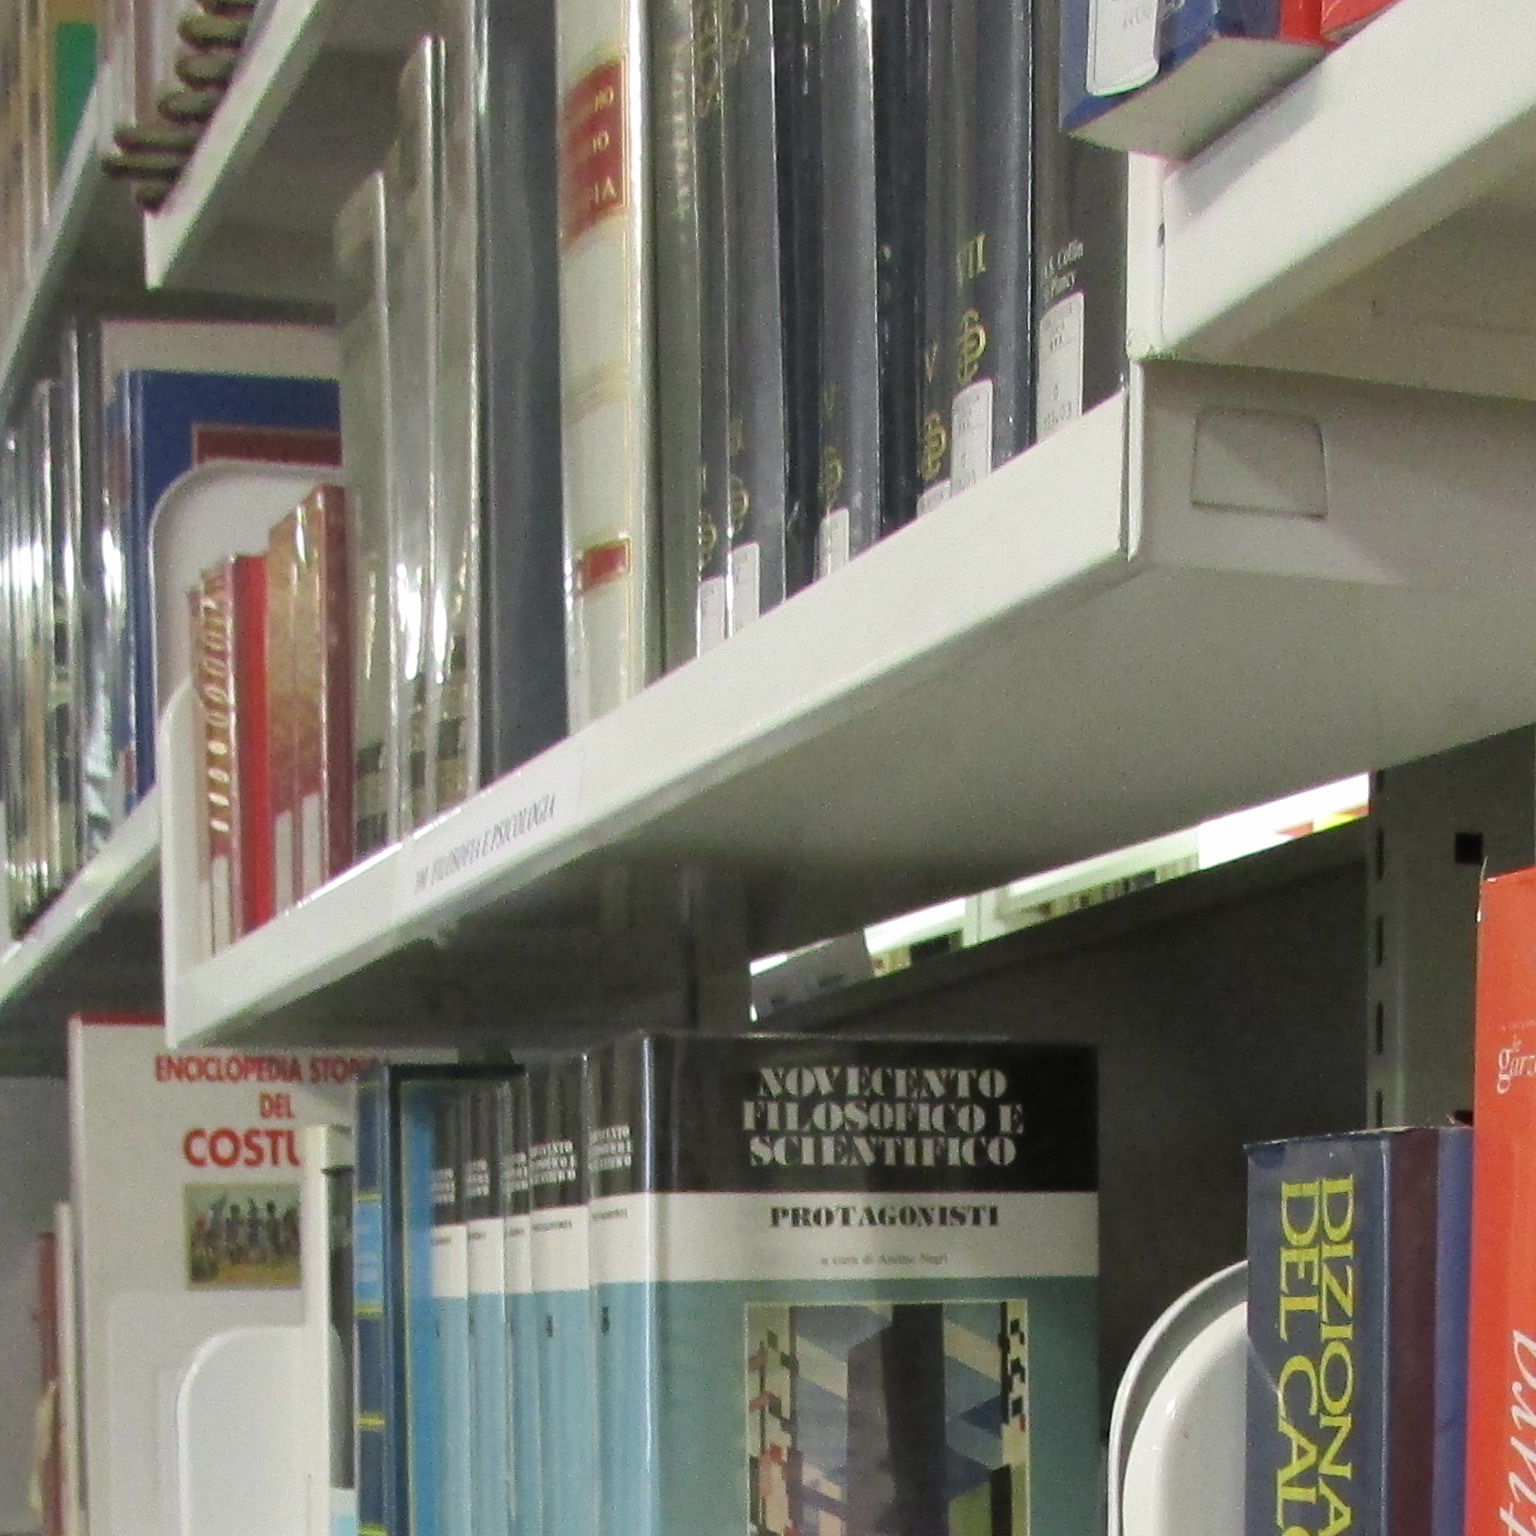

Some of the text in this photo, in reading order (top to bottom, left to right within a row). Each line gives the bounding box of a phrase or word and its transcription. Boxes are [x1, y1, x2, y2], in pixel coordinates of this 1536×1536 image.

[155, 1055, 302, 1084] ENCICLOPEDIA
[760, 1066, 1007, 1098] NOVECENTO
[259, 1092, 295, 1119] DEL
[743, 1100, 1024, 1136] FILOSOFICO E
[750, 1135, 1017, 1167] SCIENTIFICO
[770, 1204, 1000, 1229] PROTAGONISTI
[1278, 1180, 1321, 1340] DEL
